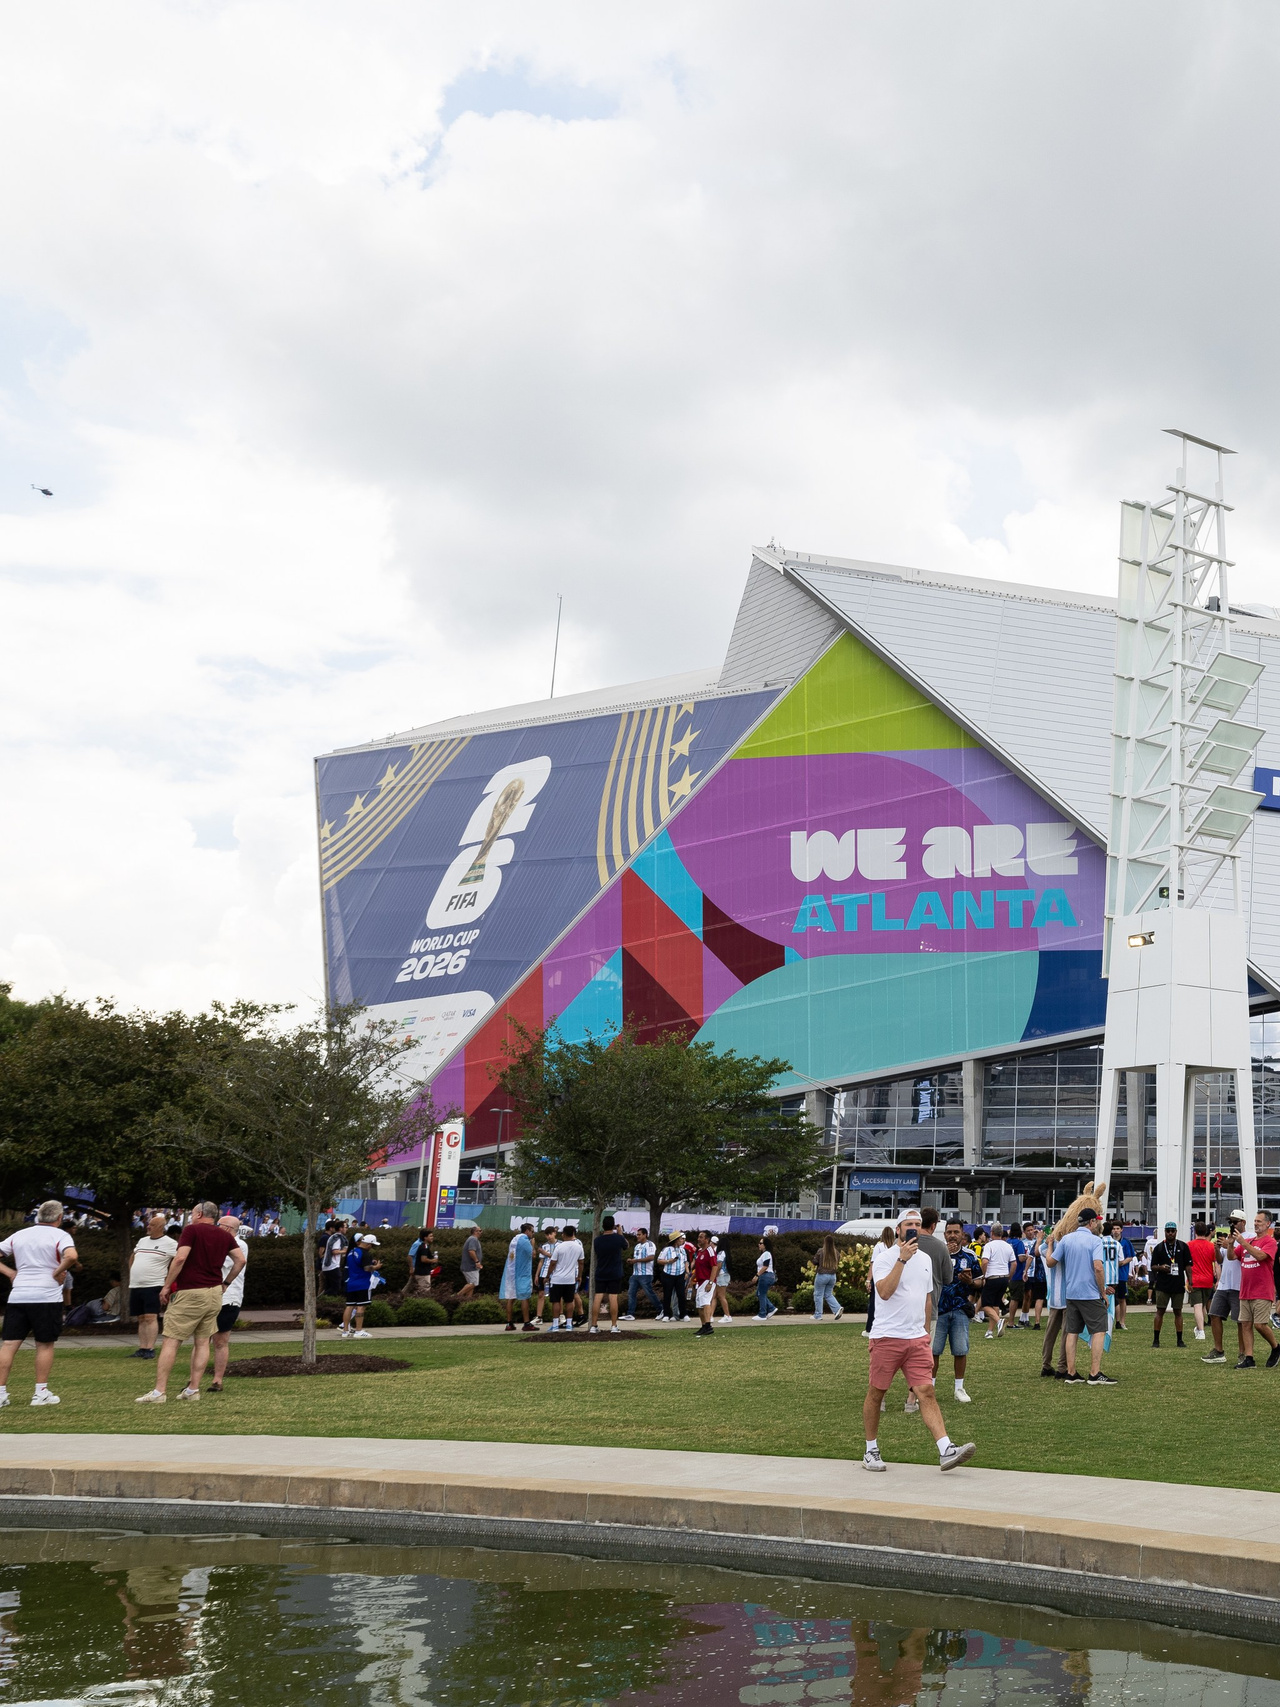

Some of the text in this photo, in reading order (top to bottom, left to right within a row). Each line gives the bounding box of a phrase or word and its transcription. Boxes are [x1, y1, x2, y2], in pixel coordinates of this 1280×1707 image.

[790, 822, 1079, 882] WE ARE
[445, 891, 478, 912] FIFA
[791, 888, 1079, 933] ATLANTA
[410, 929, 480, 954] WORLD CUP
[395, 949, 471, 983] 2026
[462, 1008, 477, 1018] VISA
[1192, 1172, 1223, 1188] TE 2
[1103, 1246, 1117, 1261] 10
